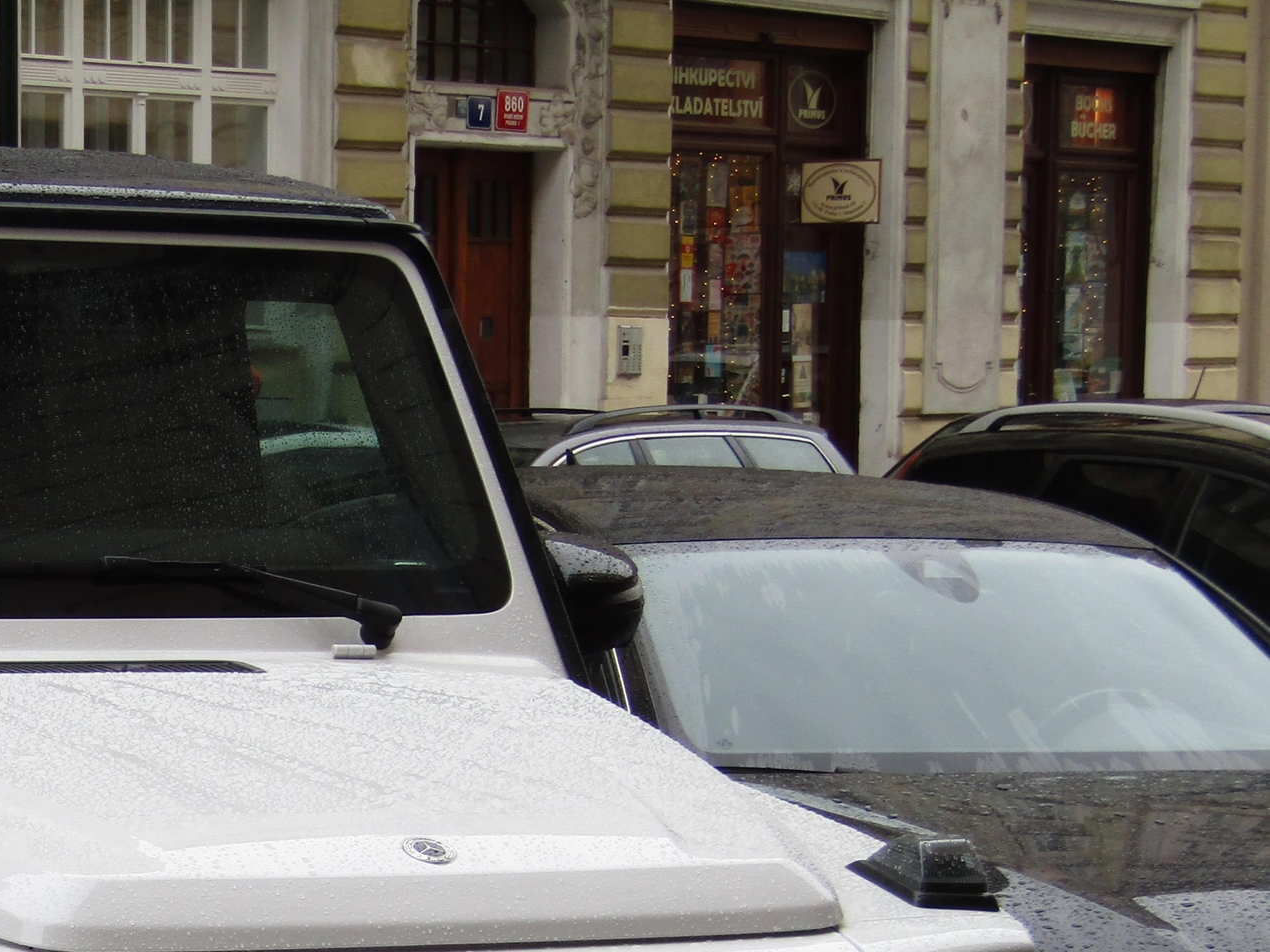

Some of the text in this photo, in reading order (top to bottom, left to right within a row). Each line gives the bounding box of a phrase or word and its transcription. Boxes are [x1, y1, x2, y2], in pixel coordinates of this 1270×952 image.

[504, 95, 524, 112] 860
[477, 104, 485, 121] 7
[798, 108, 826, 120] PRIMUS
[826, 194, 851, 202] PRIMUS
